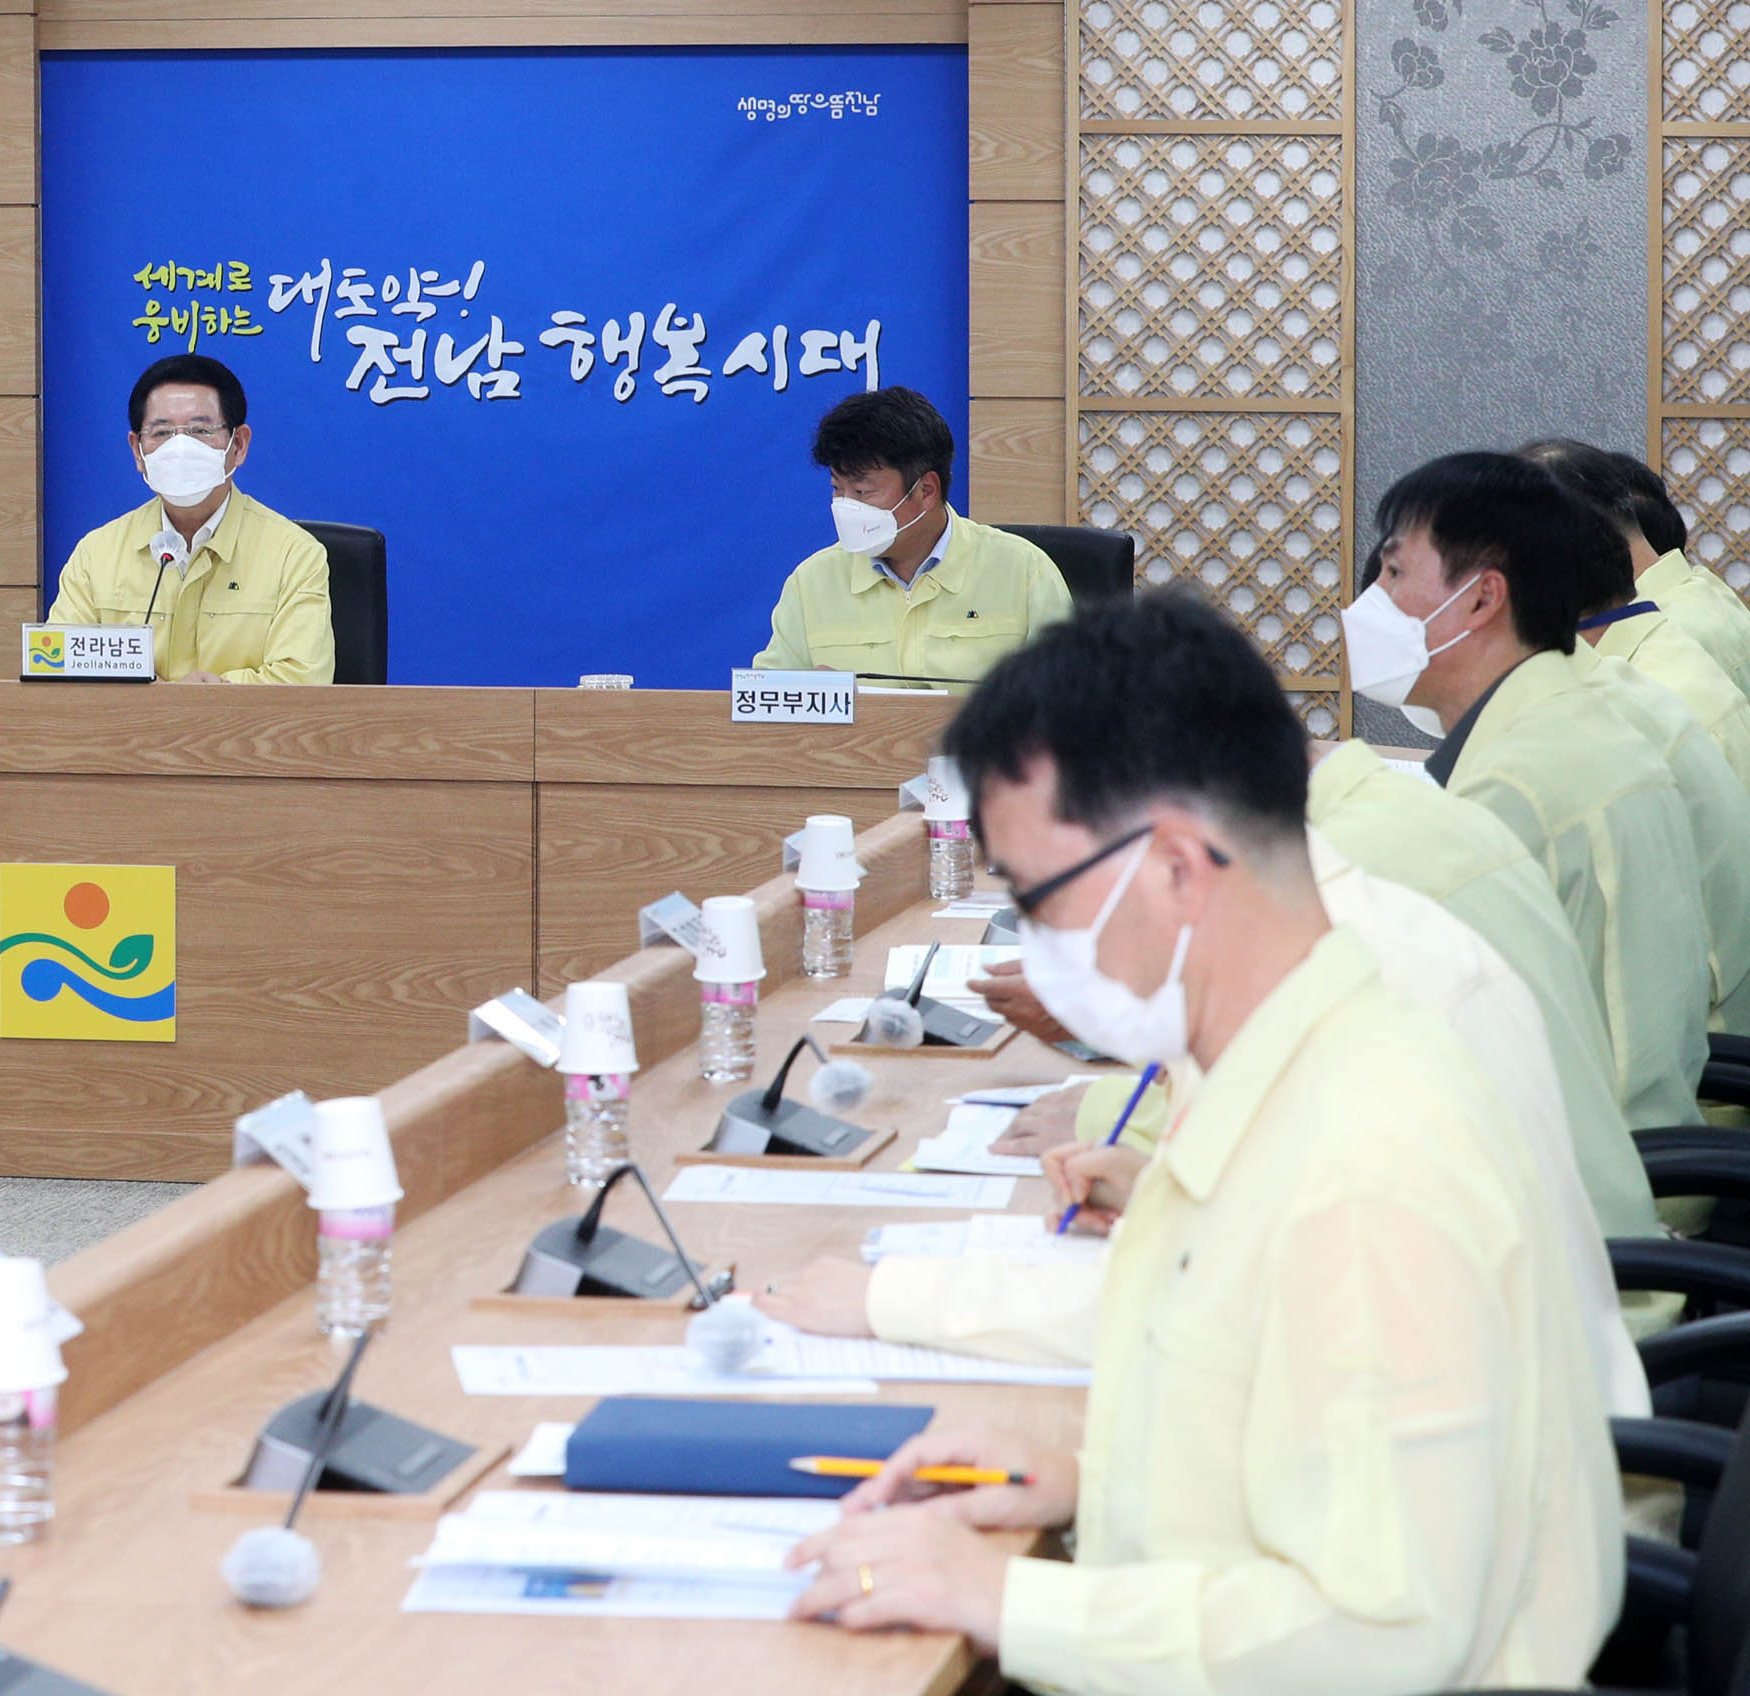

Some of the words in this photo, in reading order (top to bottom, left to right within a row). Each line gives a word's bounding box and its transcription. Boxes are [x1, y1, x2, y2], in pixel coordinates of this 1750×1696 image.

[133, 260, 253, 292] 세계로
[267, 257, 486, 363] 대도약!
[132, 299, 264, 355] 웅비하는
[345, 315, 526, 404] 전남
[70, 636, 143, 657] 전라남도
[70, 660, 143, 670] JeollaNamdo
[736, 690, 851, 715] 정무부지사
